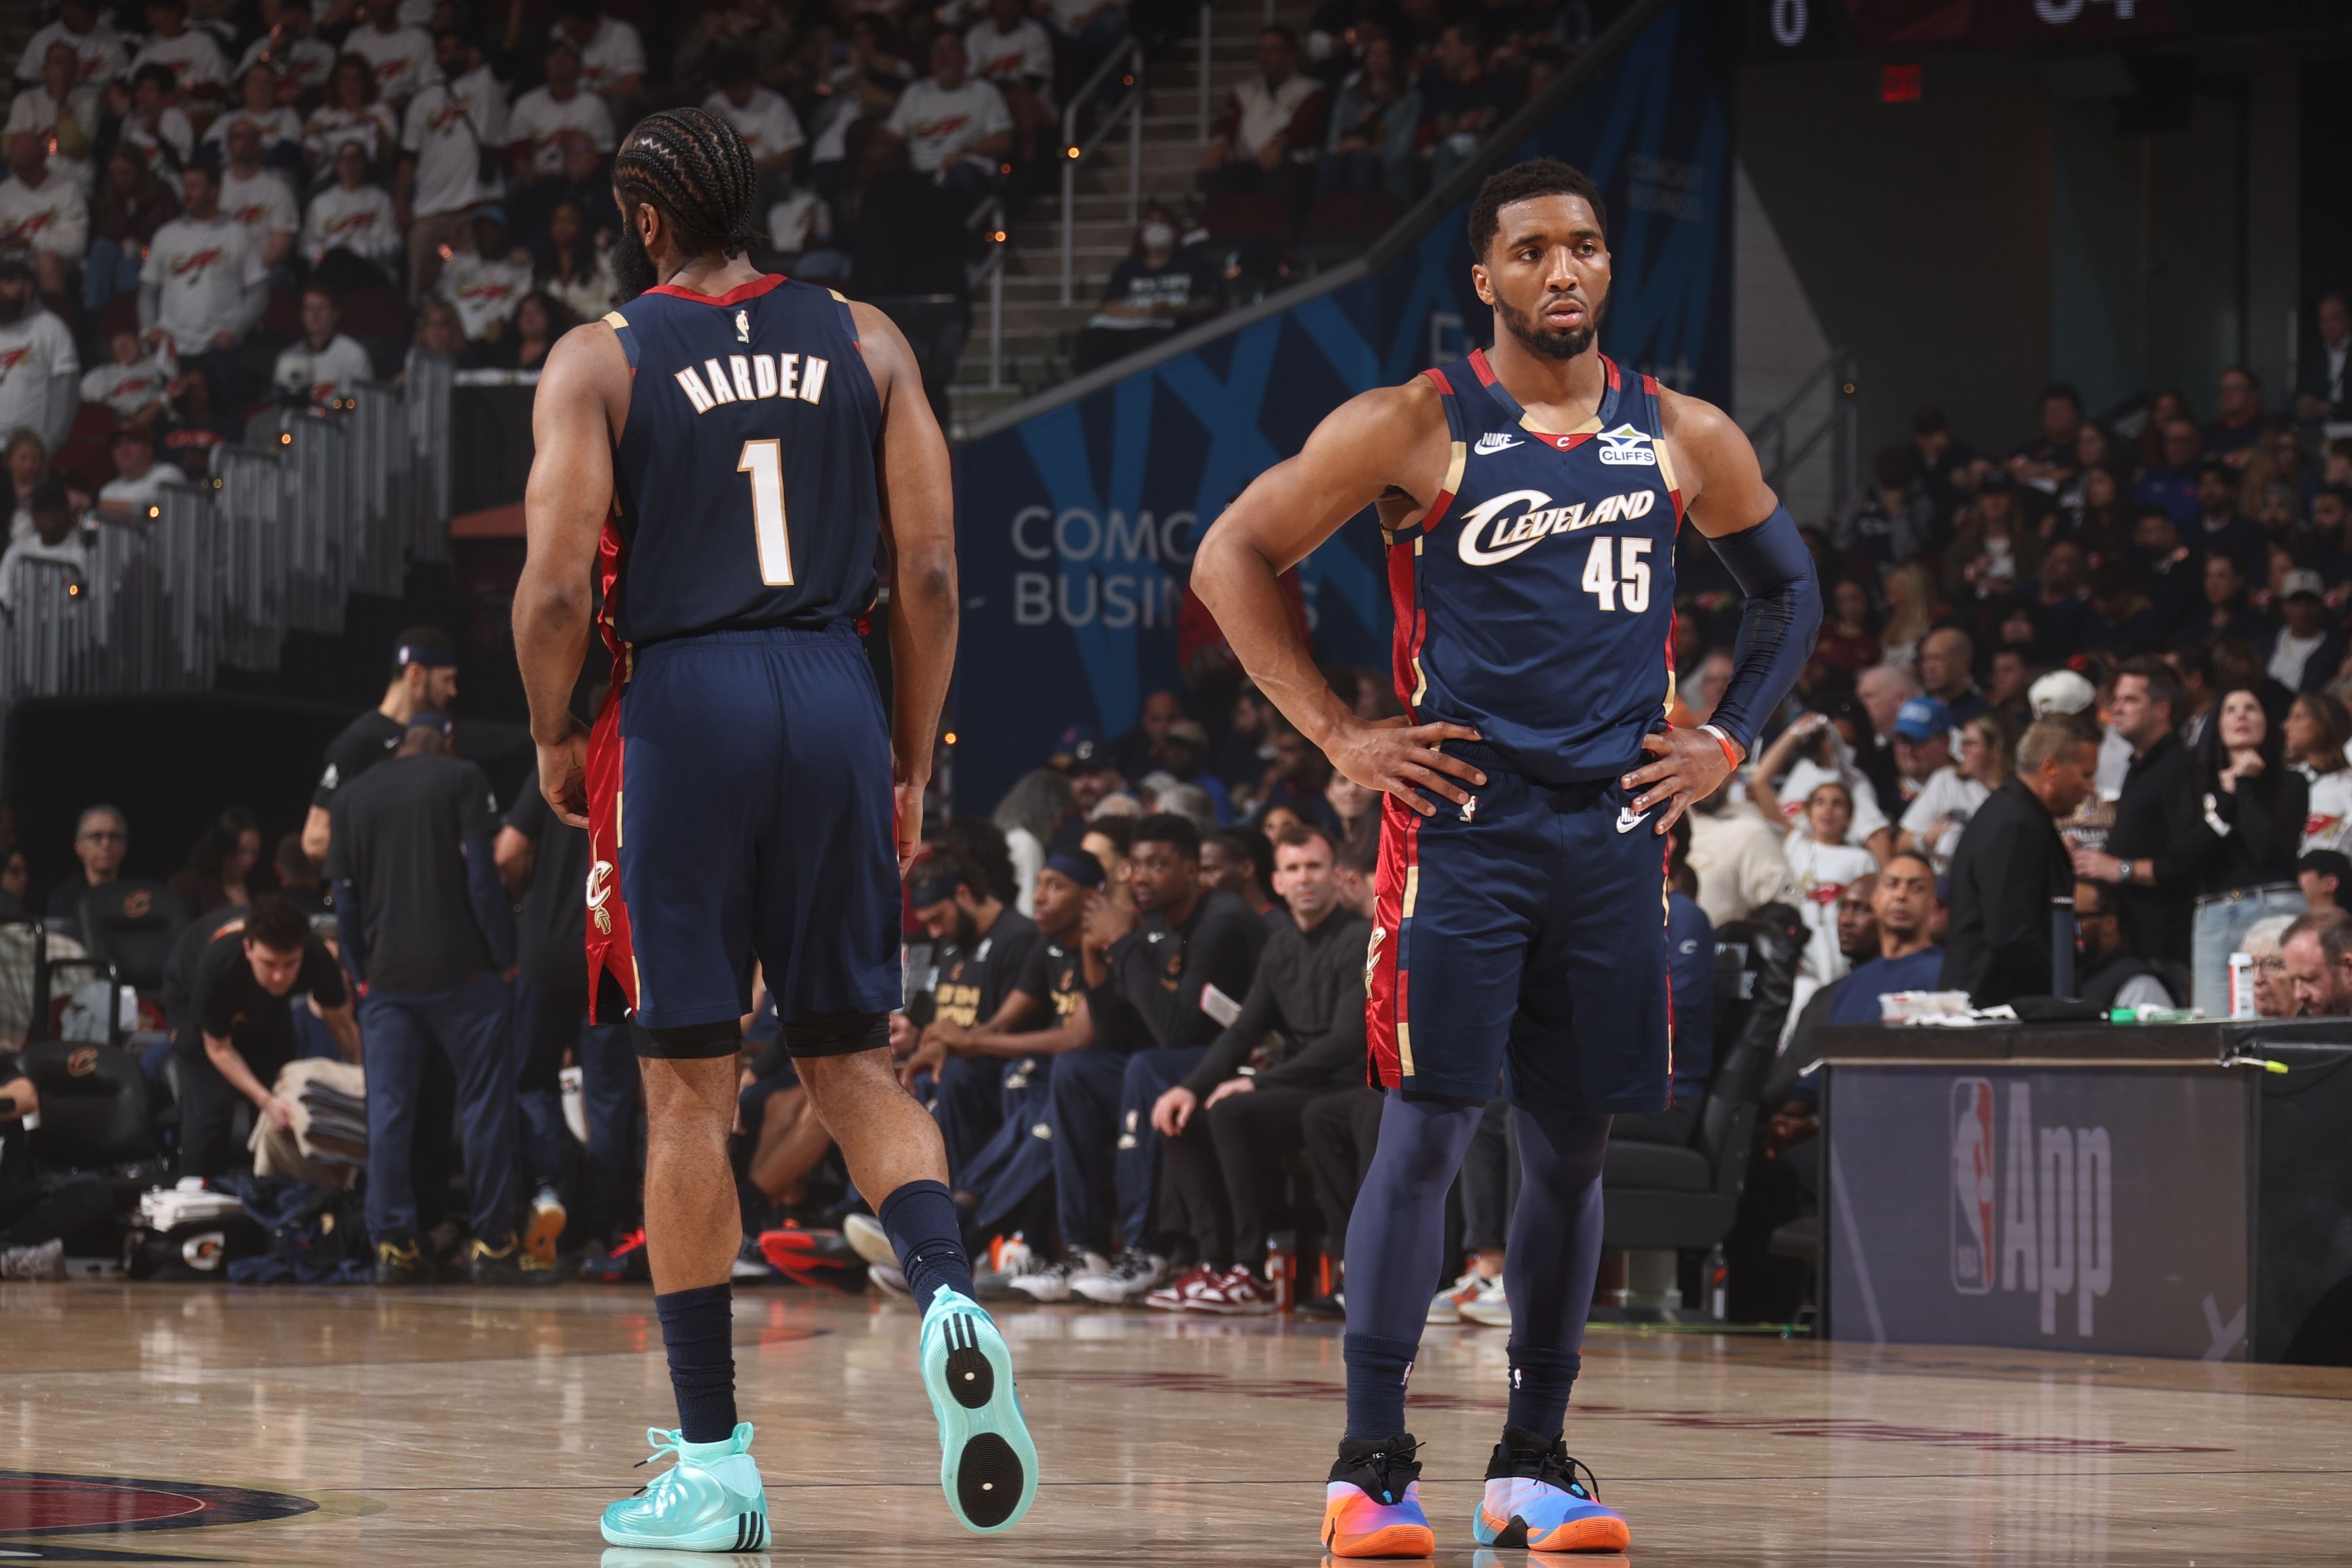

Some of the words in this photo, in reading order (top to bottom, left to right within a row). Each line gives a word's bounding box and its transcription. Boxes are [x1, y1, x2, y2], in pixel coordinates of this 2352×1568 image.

[674, 353, 828, 415] HARDEN
[1481, 432, 1513, 446] NIKE
[1602, 451, 1654, 462] CLIFFS
[736, 438, 795, 585] 1
[1011, 504, 1199, 566] COMC
[1581, 536, 1653, 613] 45
[2002, 1082, 2112, 1337] App
